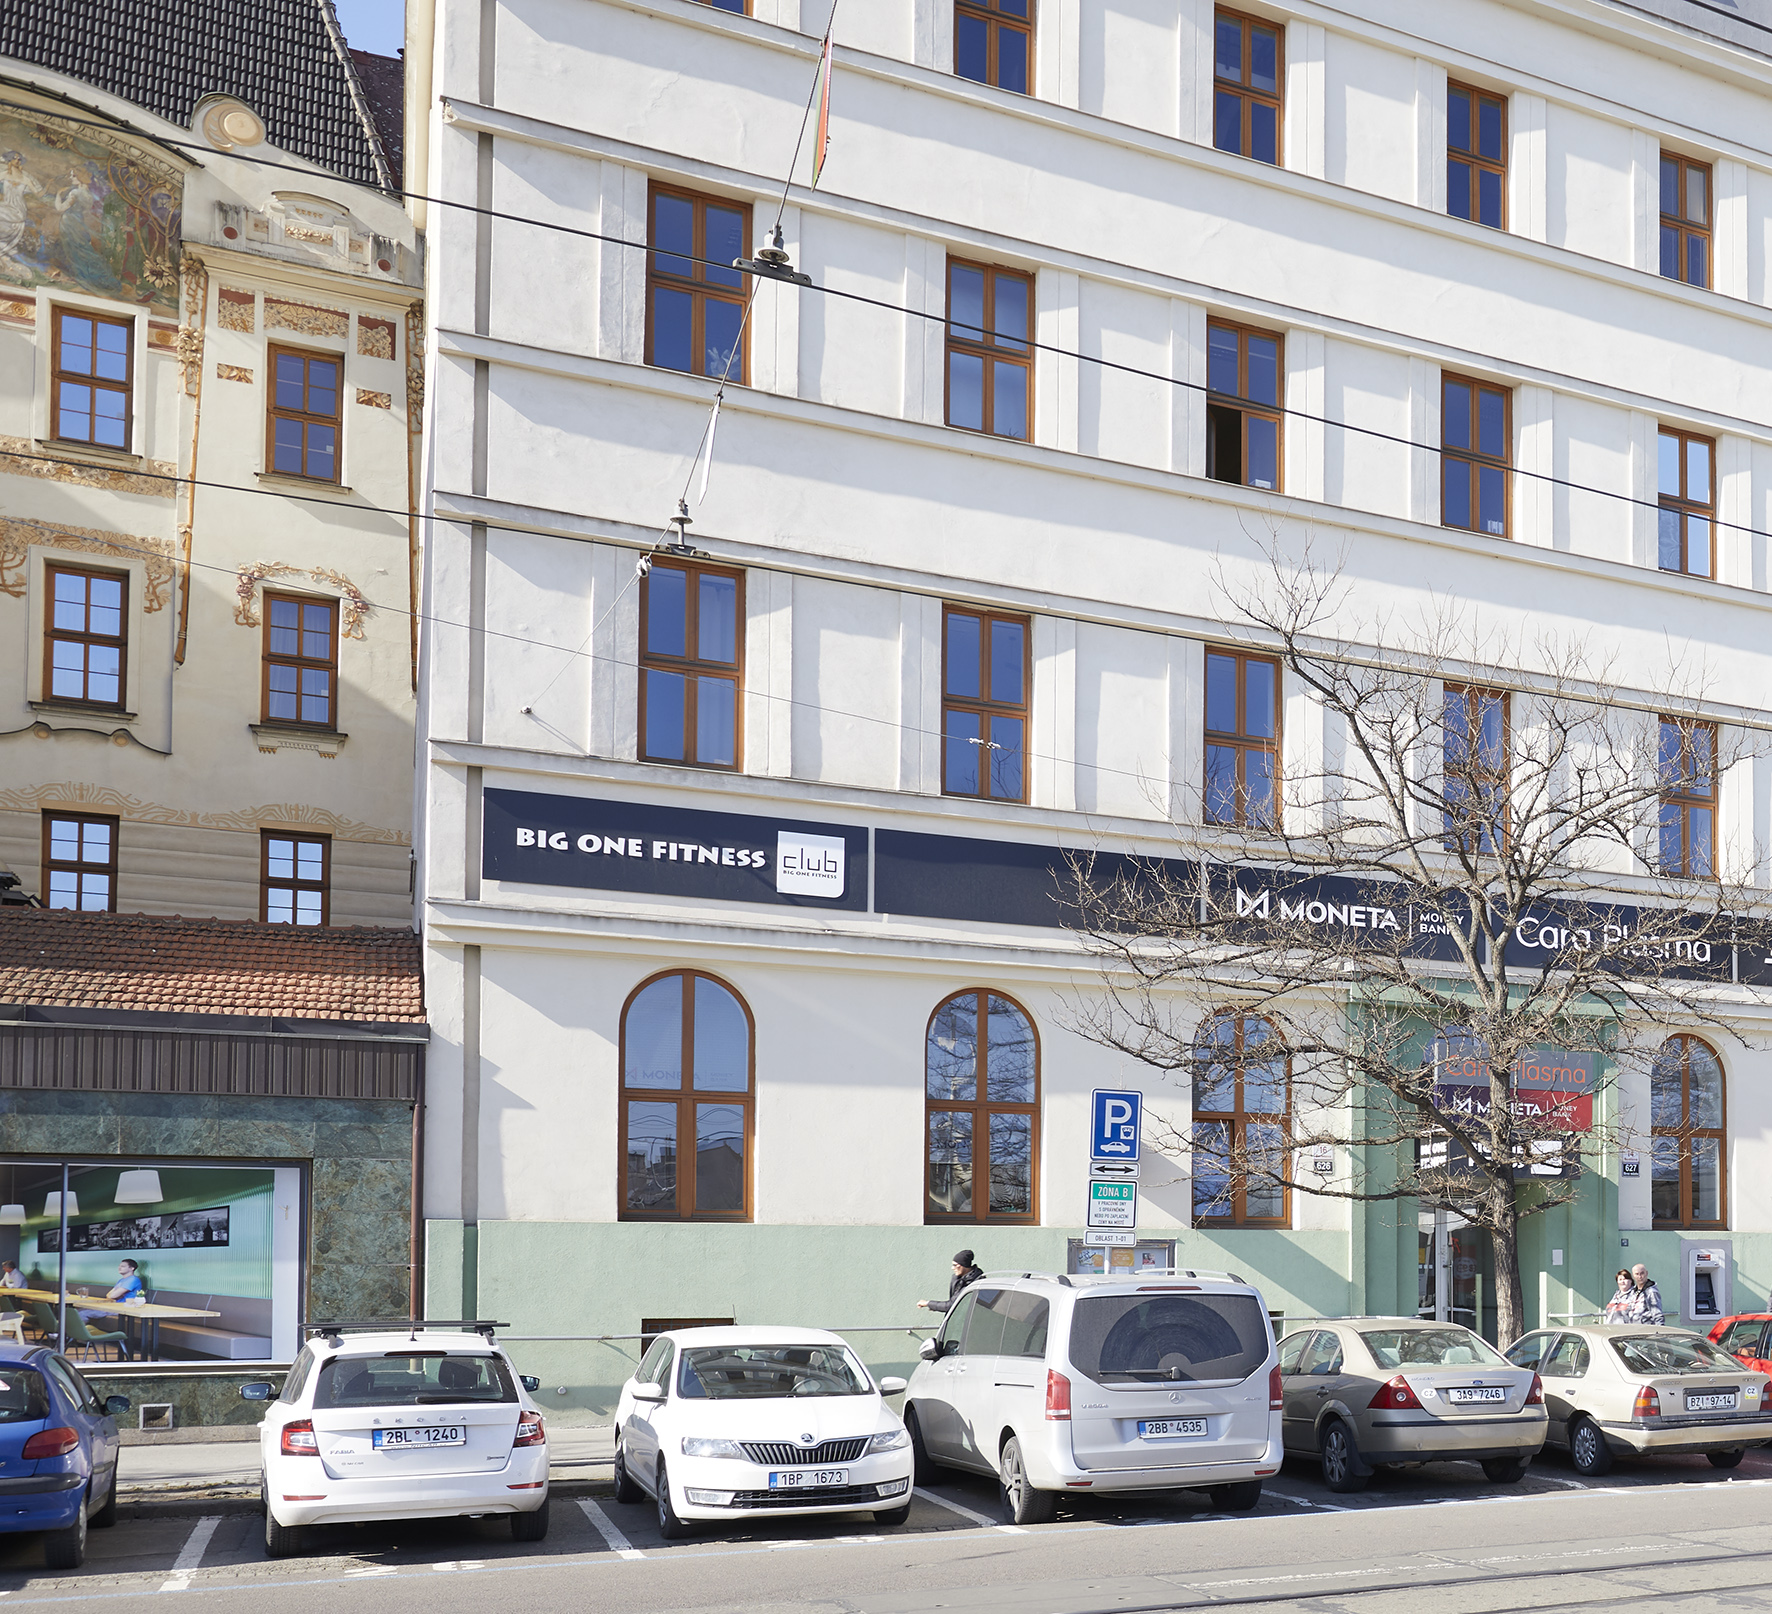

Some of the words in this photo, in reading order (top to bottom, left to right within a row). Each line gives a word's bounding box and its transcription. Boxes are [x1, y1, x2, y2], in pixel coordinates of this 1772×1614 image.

[516, 827, 569, 851] BIG
[577, 834, 643, 858] ONE
[652, 840, 766, 868] FITNESS
[783, 847, 837, 873] club
[1280, 897, 1401, 931] MONETA
[1420, 912, 1465, 925] MOY
[1515, 916, 1591, 952] Cara
[1477, 1101, 1542, 1116] META
[1104, 1099, 1133, 1138] P
[1316, 1162, 1331, 1170] 626
[1625, 1164, 1637, 1172] 627
[1097, 1184, 1120, 1197] ZÓNA
[1122, 1187, 1129, 1198] B
[1456, 1390, 1473, 1400] 3A9
[1479, 1388, 1501, 1399] 7246
[1709, 1395, 1732, 1406] 97-14
[1148, 1423, 1168, 1434] 2BB
[1176, 1421, 1202, 1433] 4535
[386, 1431, 412, 1444] 2BL
[424, 1428, 458, 1441] 1240
[781, 1473, 803, 1486] 1BP
[814, 1471, 843, 1484] 1673
